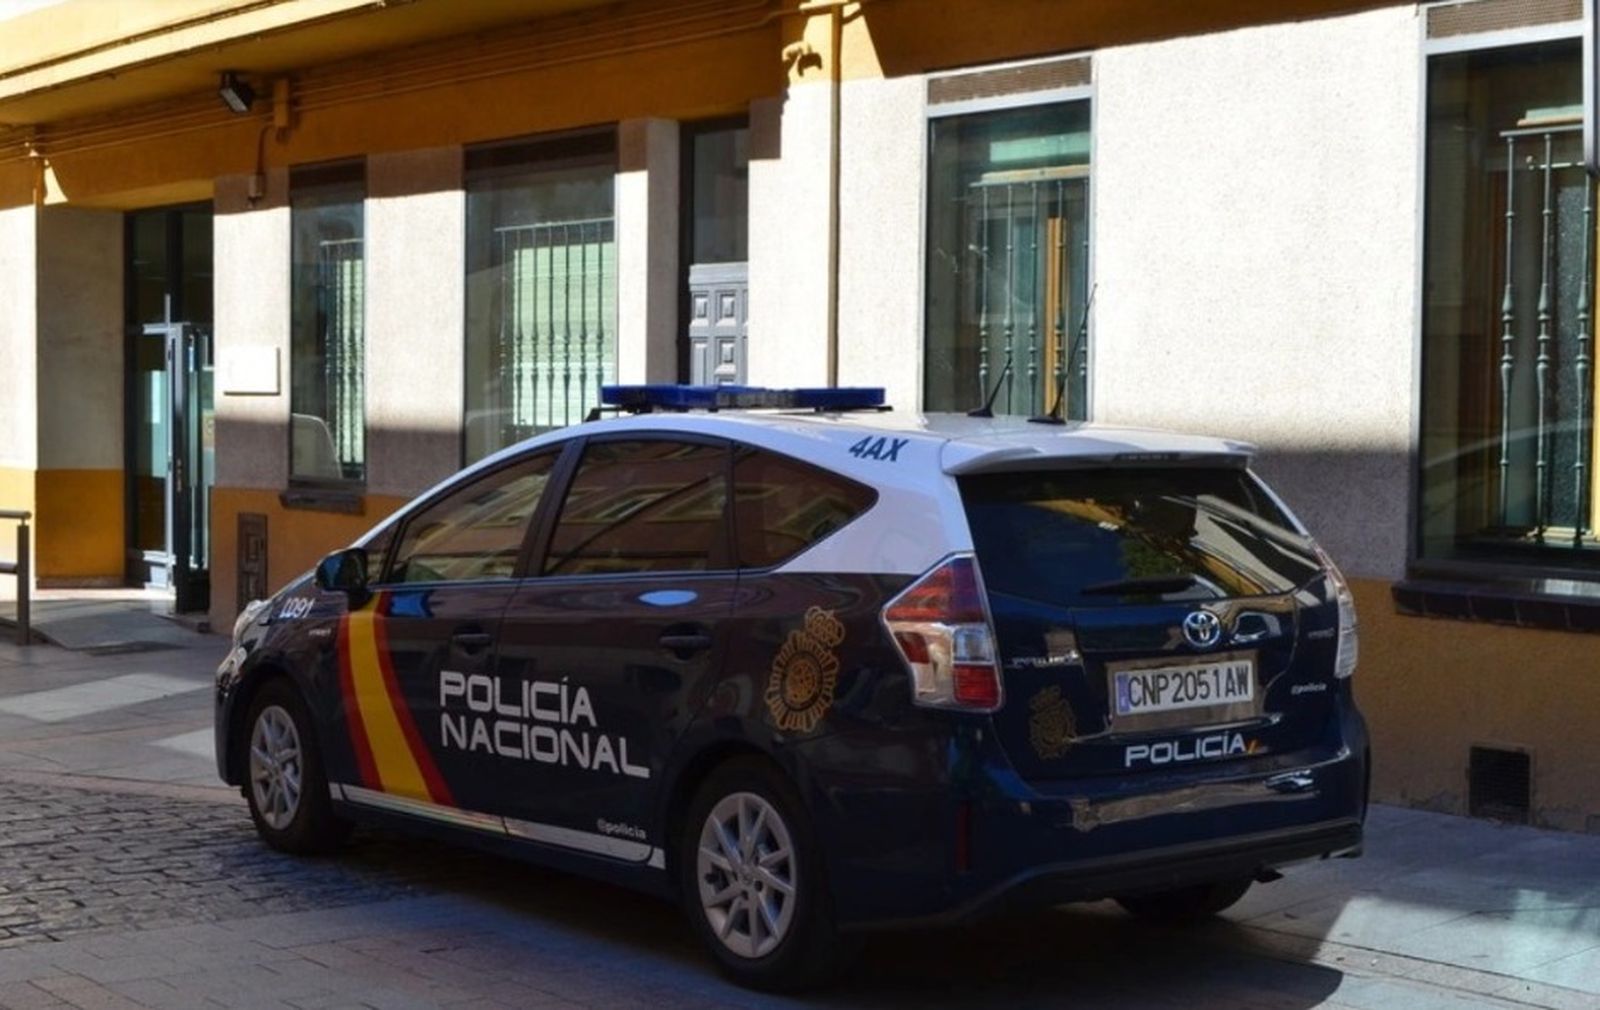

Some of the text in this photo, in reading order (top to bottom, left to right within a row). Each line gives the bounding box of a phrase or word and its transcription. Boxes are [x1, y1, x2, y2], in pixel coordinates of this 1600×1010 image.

[849, 435, 909, 461] 4AX
[440, 671, 598, 727] POLICÍA
[440, 713, 650, 778] NACIONAL
[1125, 731, 1247, 767] POLICÍA
